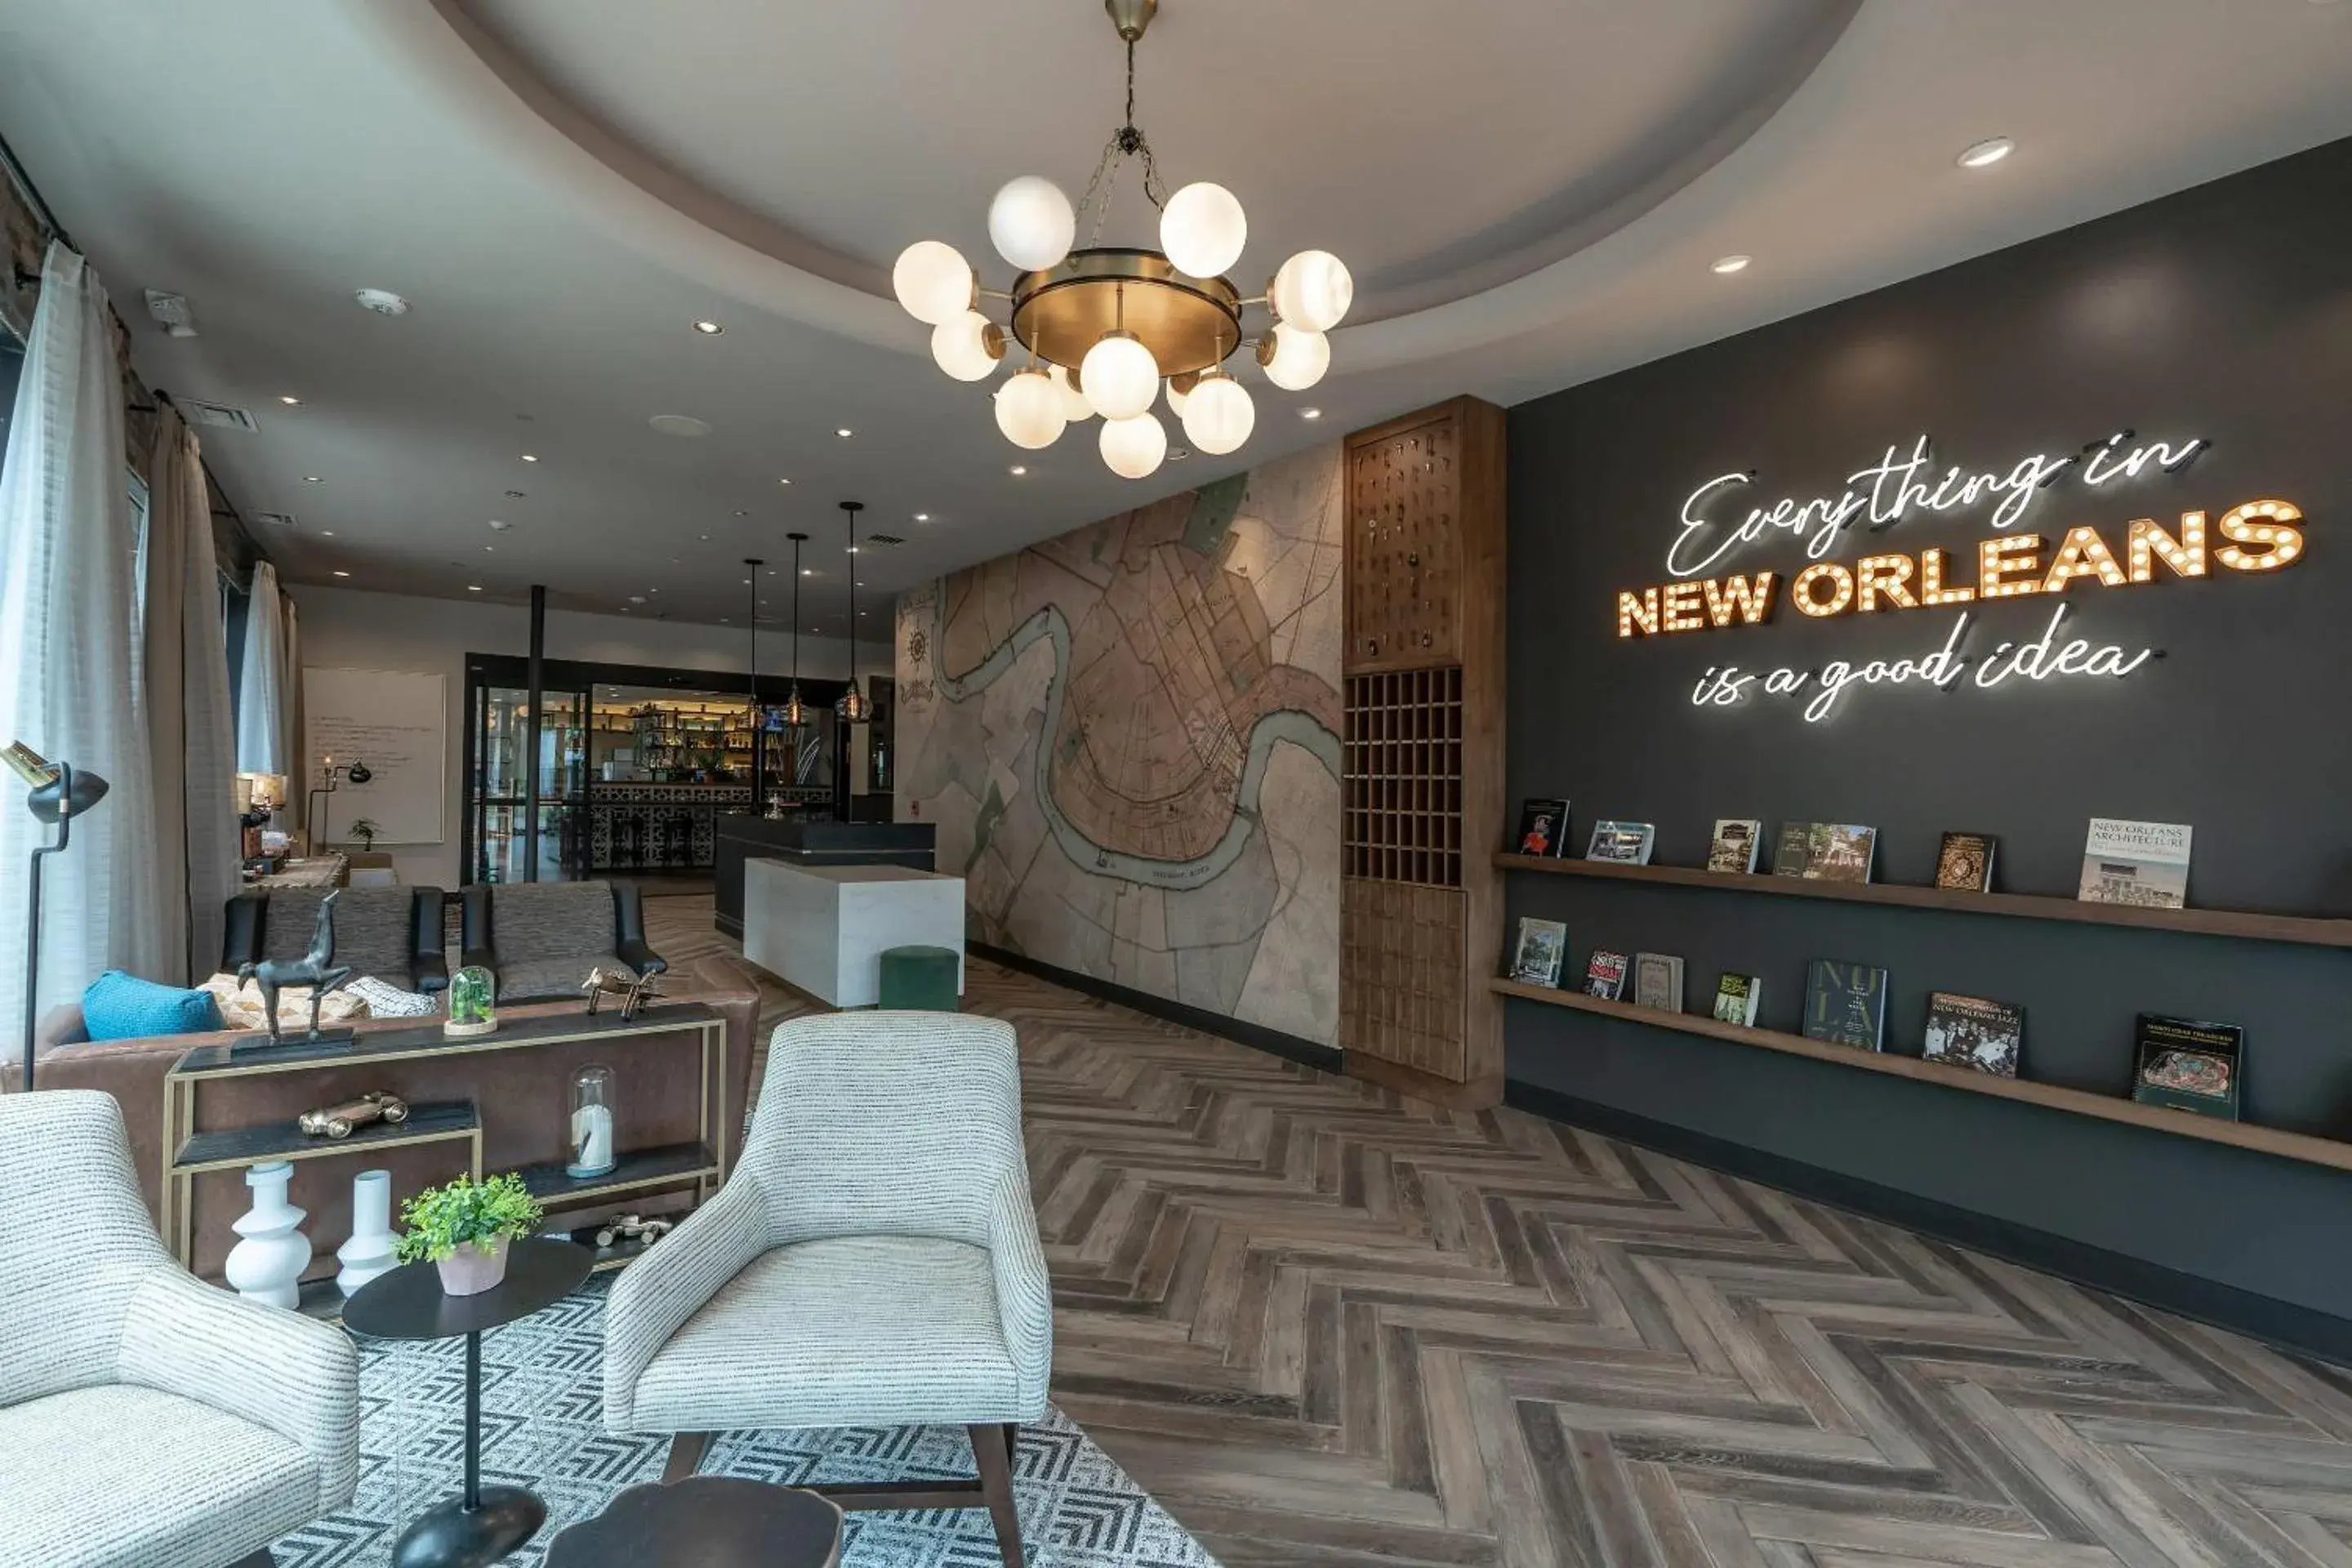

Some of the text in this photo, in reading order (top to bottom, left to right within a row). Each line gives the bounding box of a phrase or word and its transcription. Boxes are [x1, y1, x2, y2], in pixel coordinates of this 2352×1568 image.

[1667, 433, 2200, 577] Everything in
[1619, 499, 2304, 638] NEW ORLEANS
[1692, 602, 2151, 722] is a good idea
[2094, 822, 2183, 837] NEW ORLEANS
[2094, 831, 2184, 848] ARCHITECTURE
